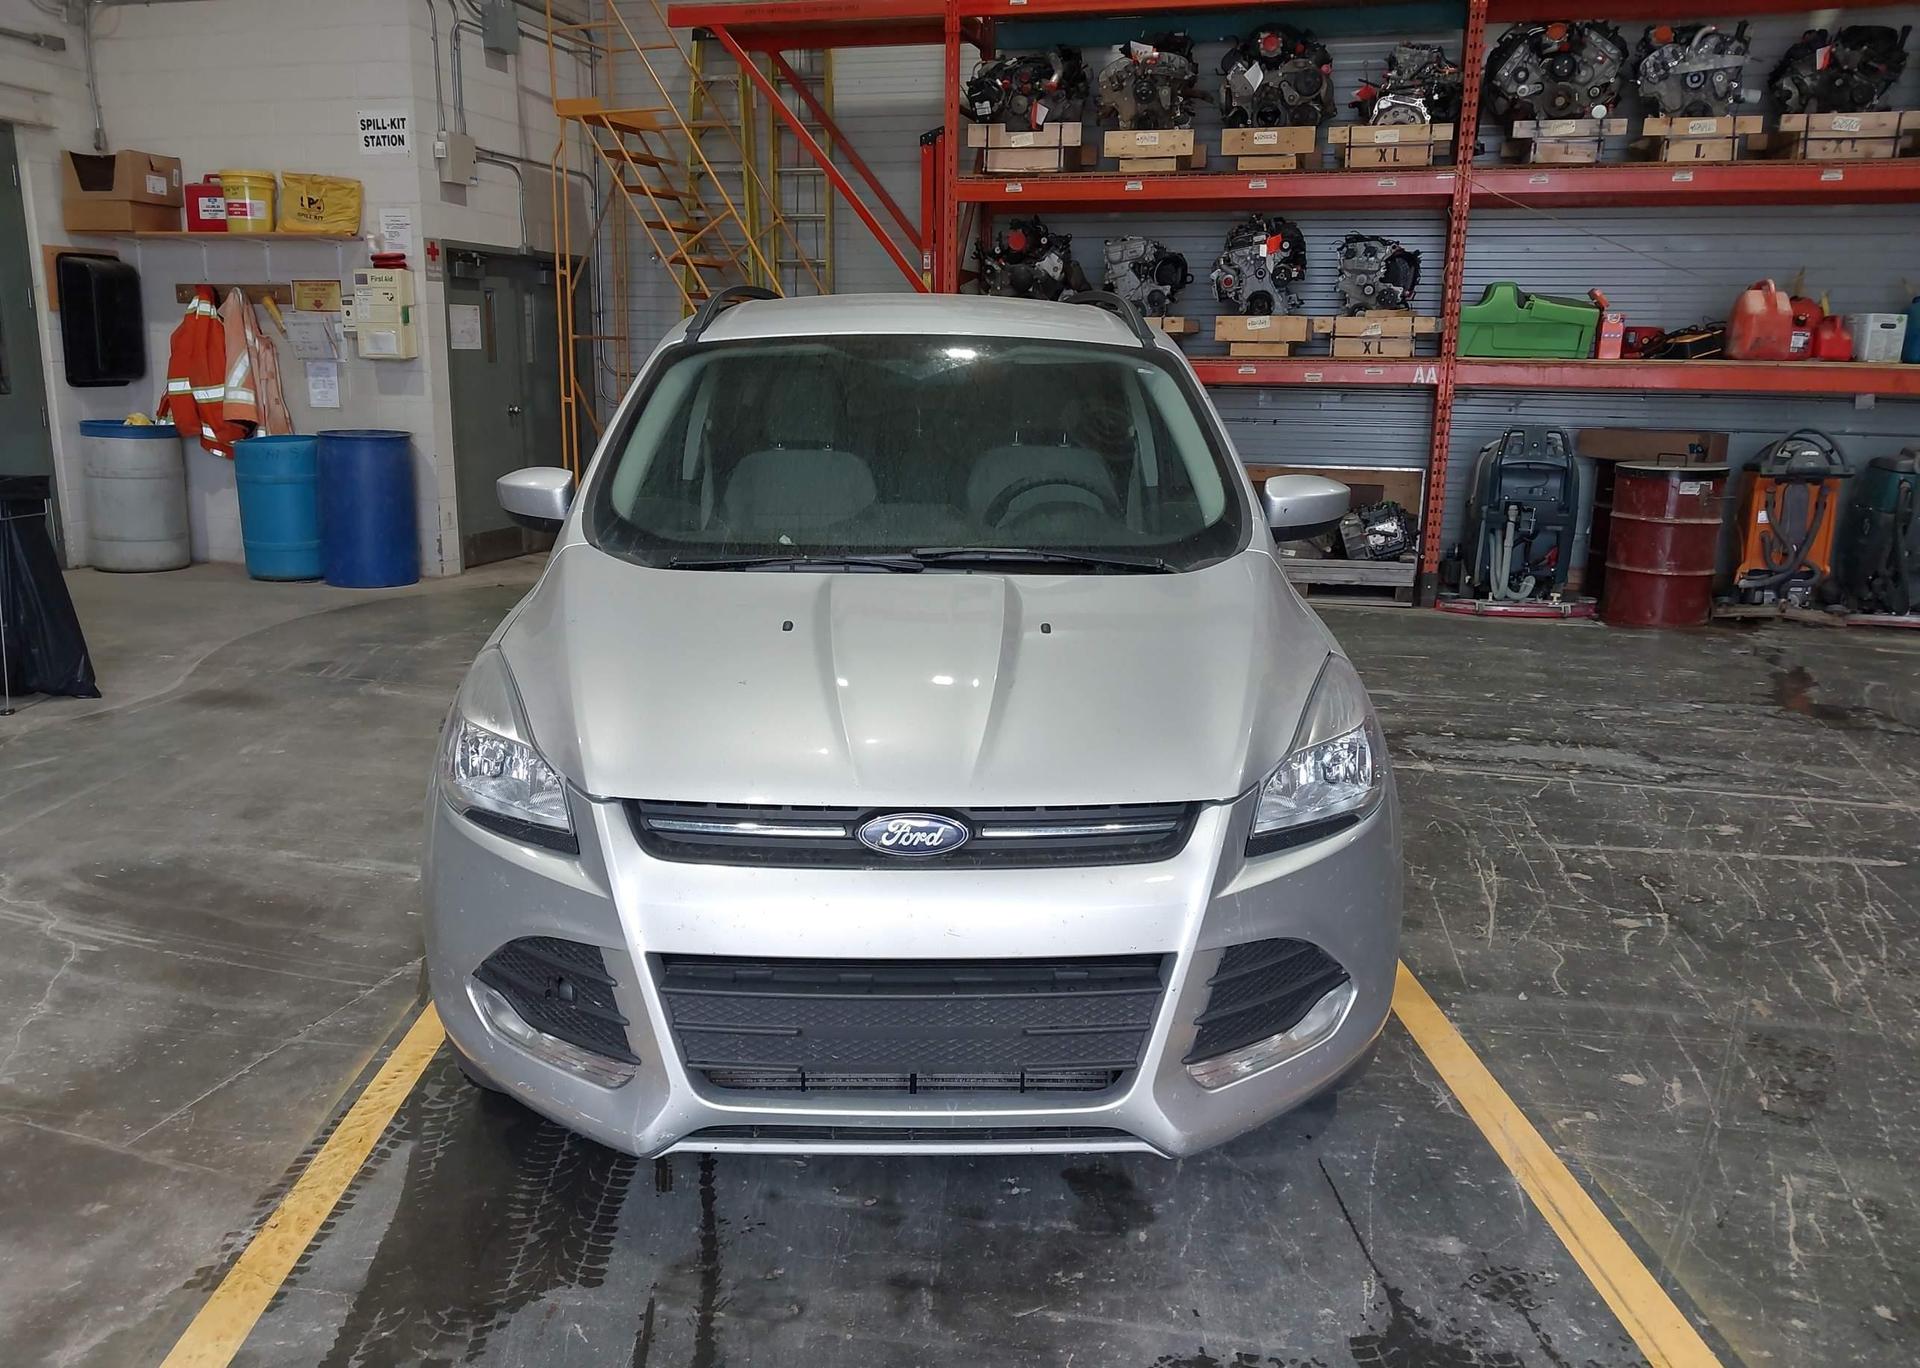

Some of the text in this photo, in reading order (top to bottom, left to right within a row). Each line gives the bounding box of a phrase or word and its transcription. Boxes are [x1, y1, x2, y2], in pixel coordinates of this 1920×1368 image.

[360, 117, 406, 131] SPILL-KIT
[363, 134, 405, 147] STATION
[1412, 366, 1439, 384] AA
[881, 819, 945, 846] Ford
